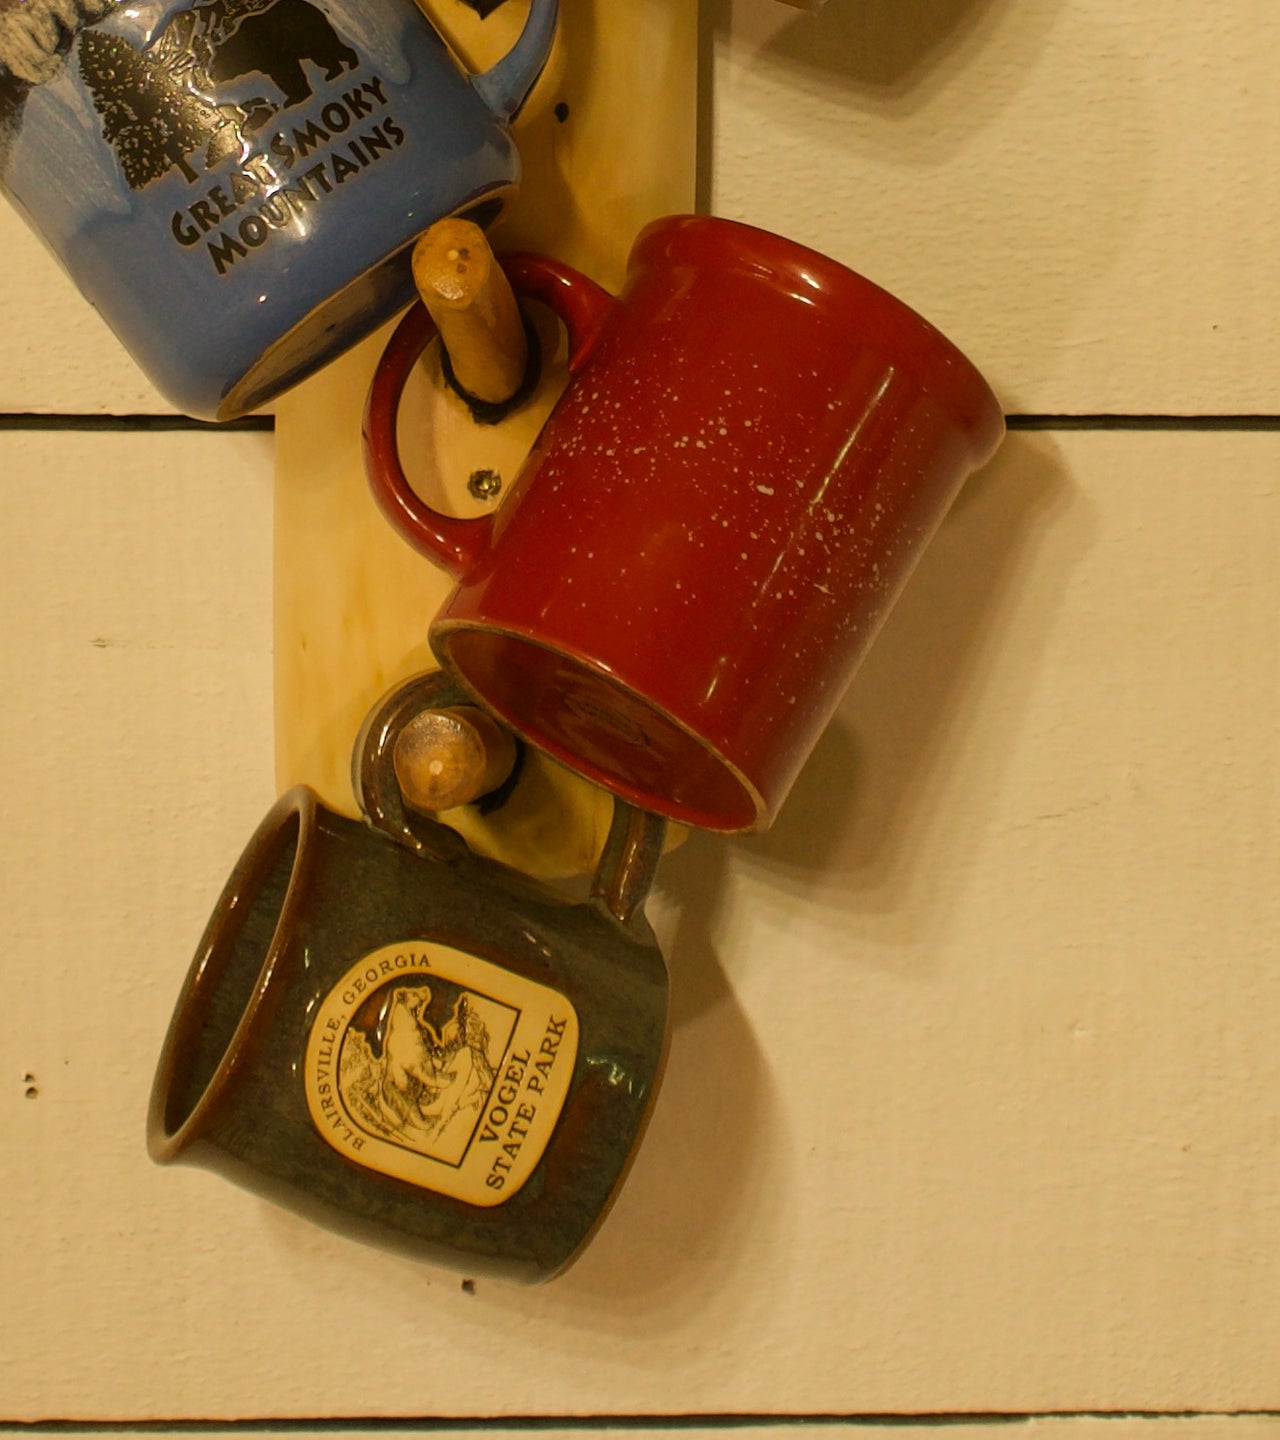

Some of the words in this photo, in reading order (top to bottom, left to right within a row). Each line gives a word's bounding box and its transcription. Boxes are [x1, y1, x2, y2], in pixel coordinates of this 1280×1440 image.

[171, 154, 281, 247] GREAT
[270, 76, 389, 169] SMOKY
[205, 116, 404, 275] MOUNTAINS
[316, 1014, 365, 1151] BLAIRSVILLE,
[343, 952, 432, 1005] GEORGIA
[479, 1049, 531, 1145] VOGEL
[485, 1105, 536, 1191] STATE
[528, 1013, 568, 1096] PARK
